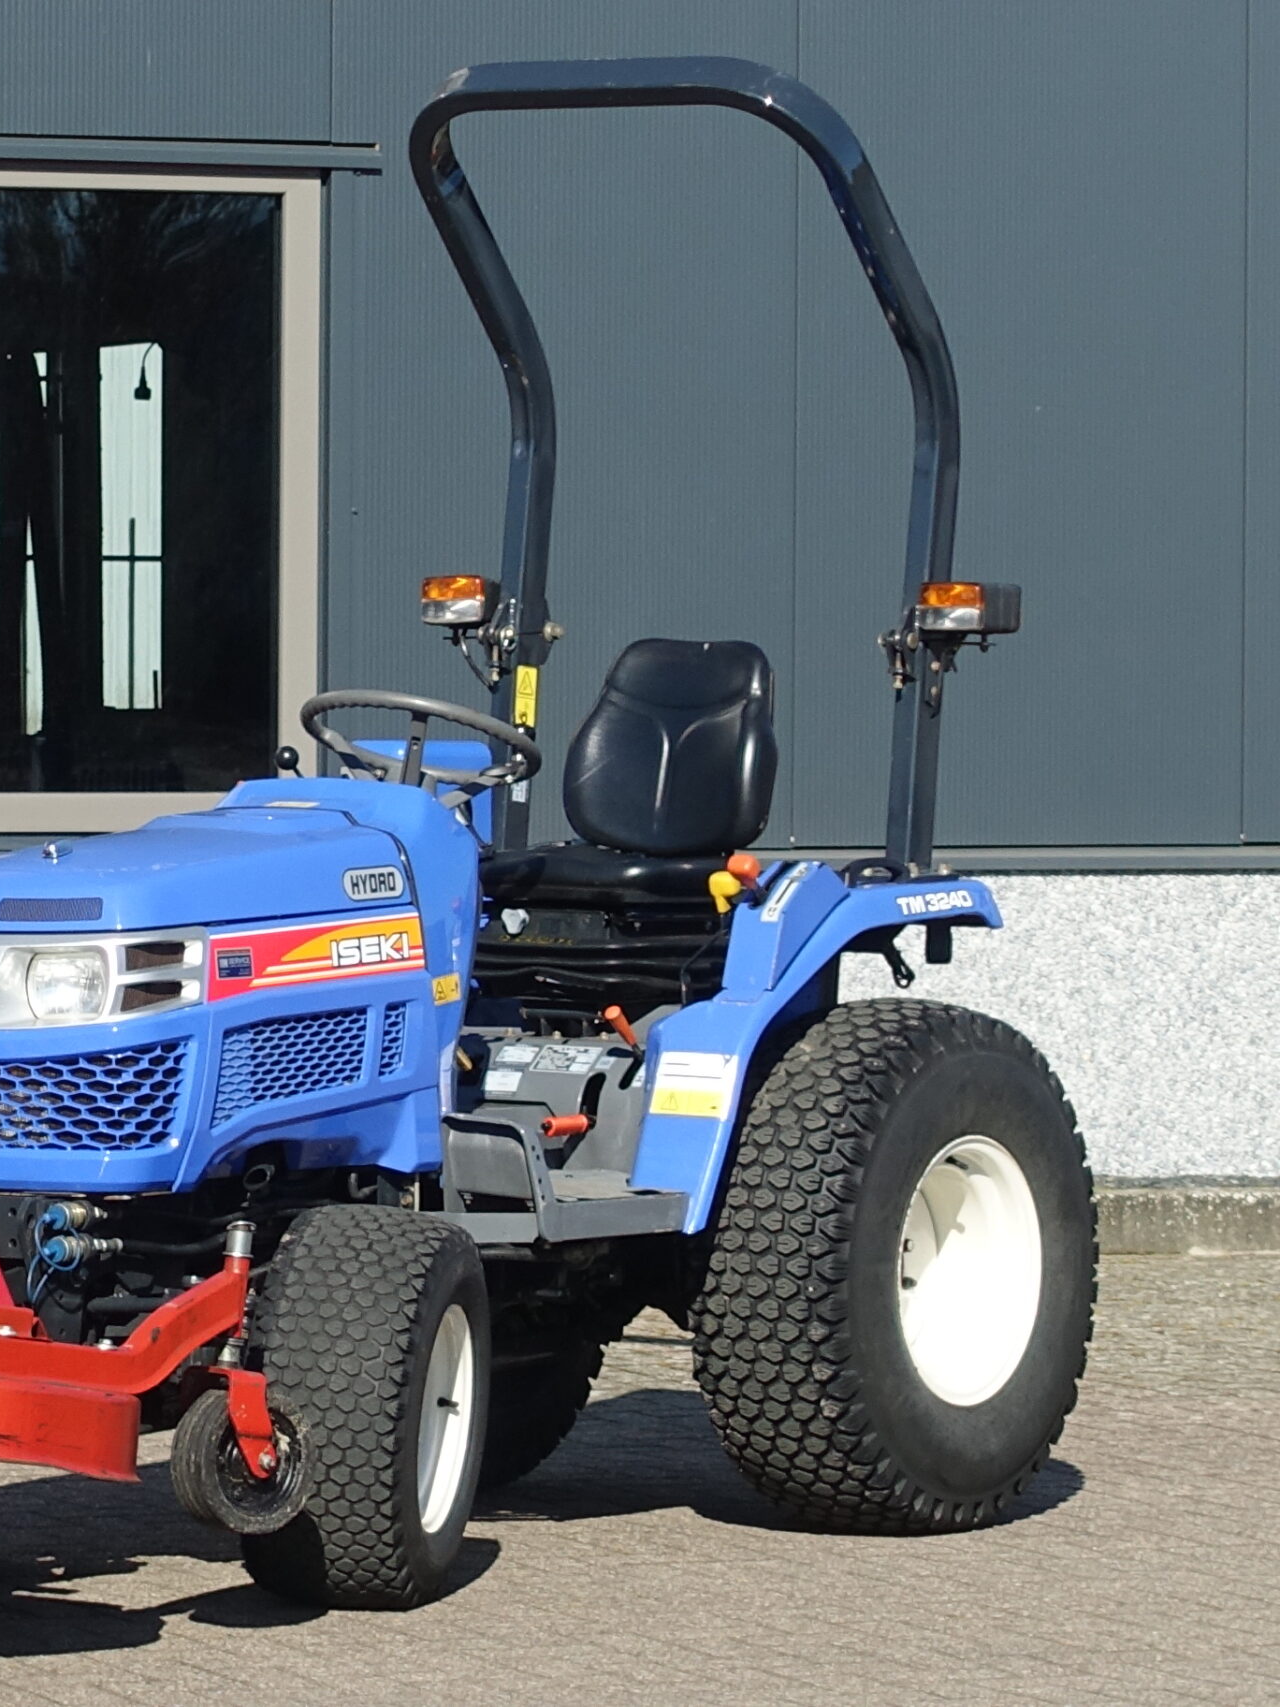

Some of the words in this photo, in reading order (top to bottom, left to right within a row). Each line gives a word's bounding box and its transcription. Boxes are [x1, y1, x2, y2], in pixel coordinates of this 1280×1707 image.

[350, 872, 396, 895] HYDRO
[896, 895, 926, 915] TM
[927, 890, 973, 912] 3240
[330, 931, 410, 967] ISEKI
